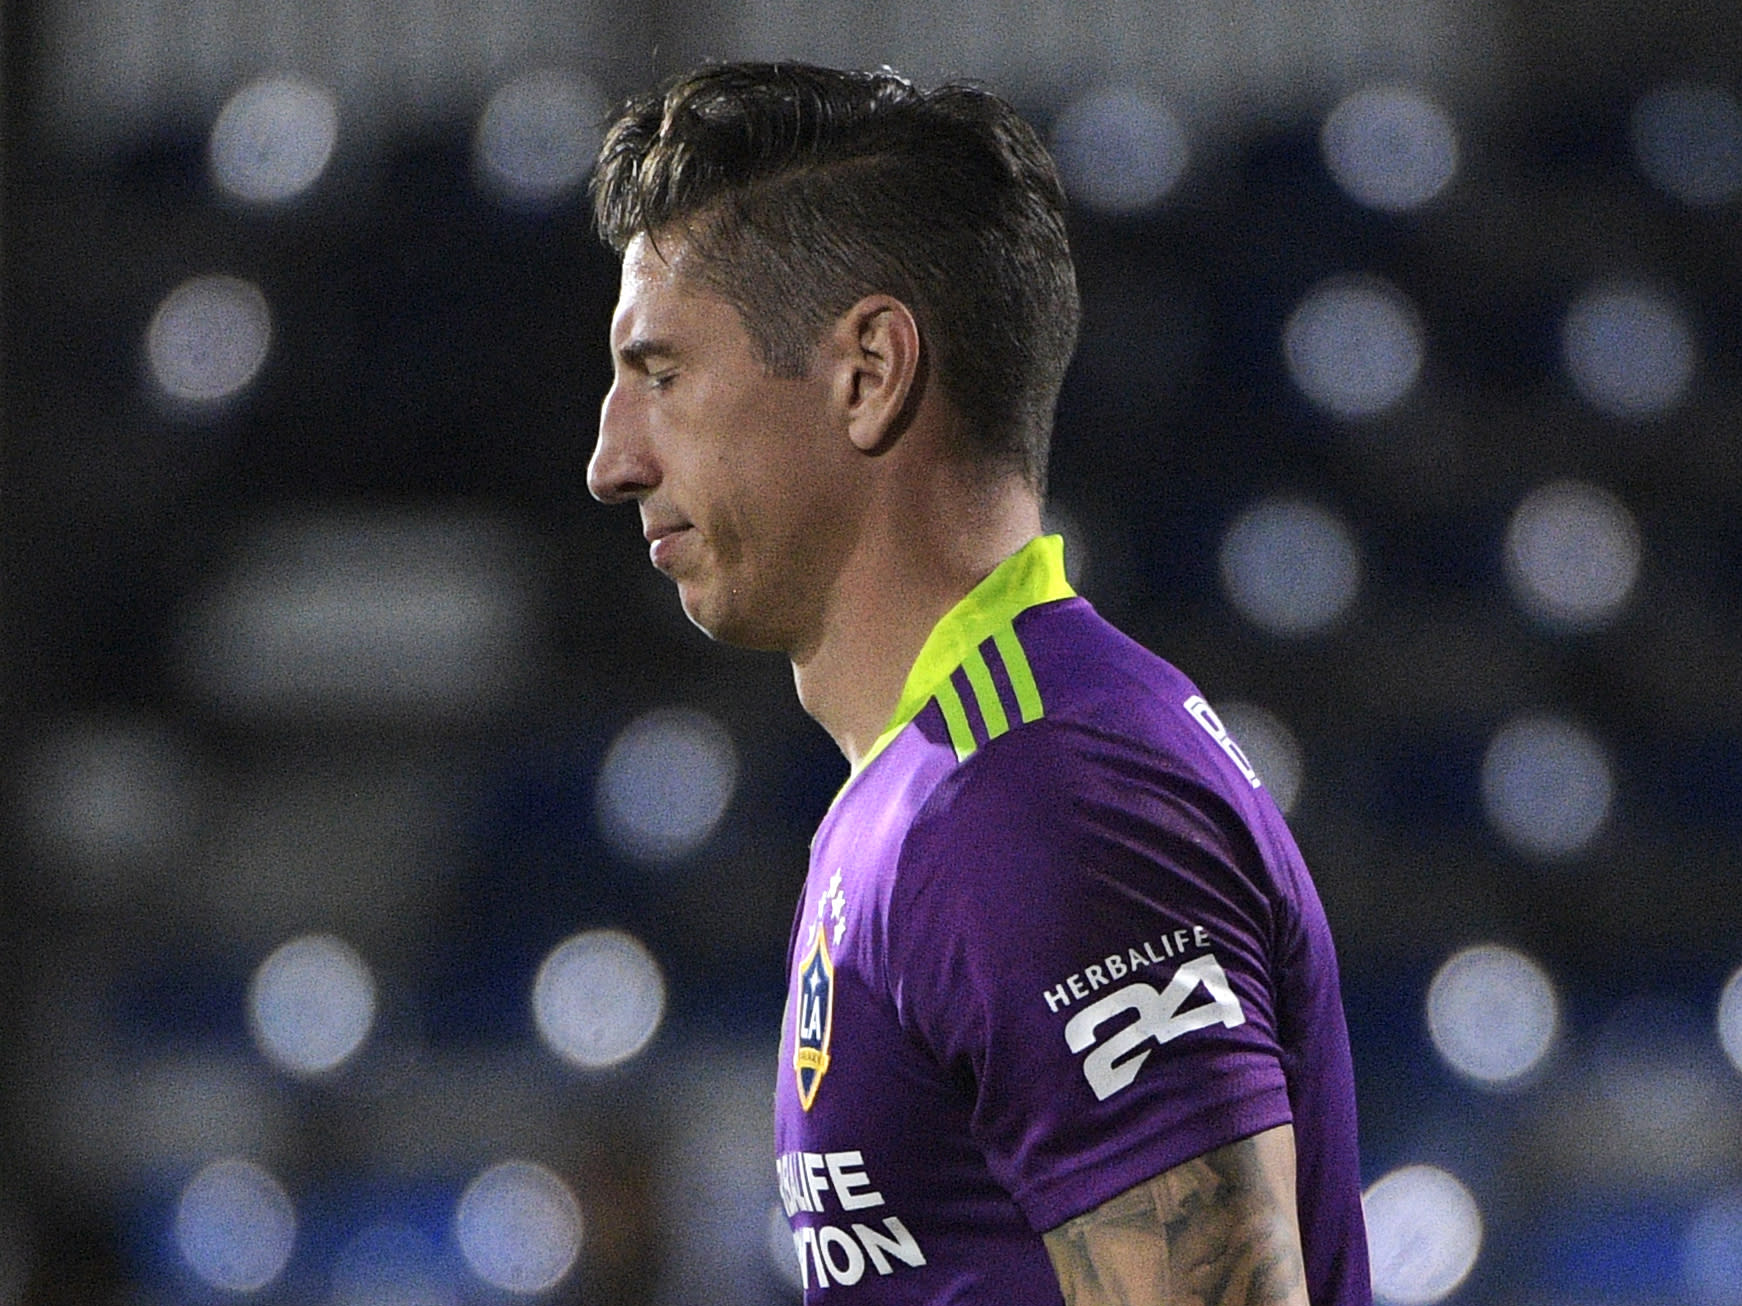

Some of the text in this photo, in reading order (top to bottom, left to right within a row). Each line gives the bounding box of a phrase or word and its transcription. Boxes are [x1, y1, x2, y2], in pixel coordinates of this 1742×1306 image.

[1043, 925, 1210, 1013] HERBALIFE
[801, 993, 821, 1040] LA
[1065, 953, 1246, 1101] 24
